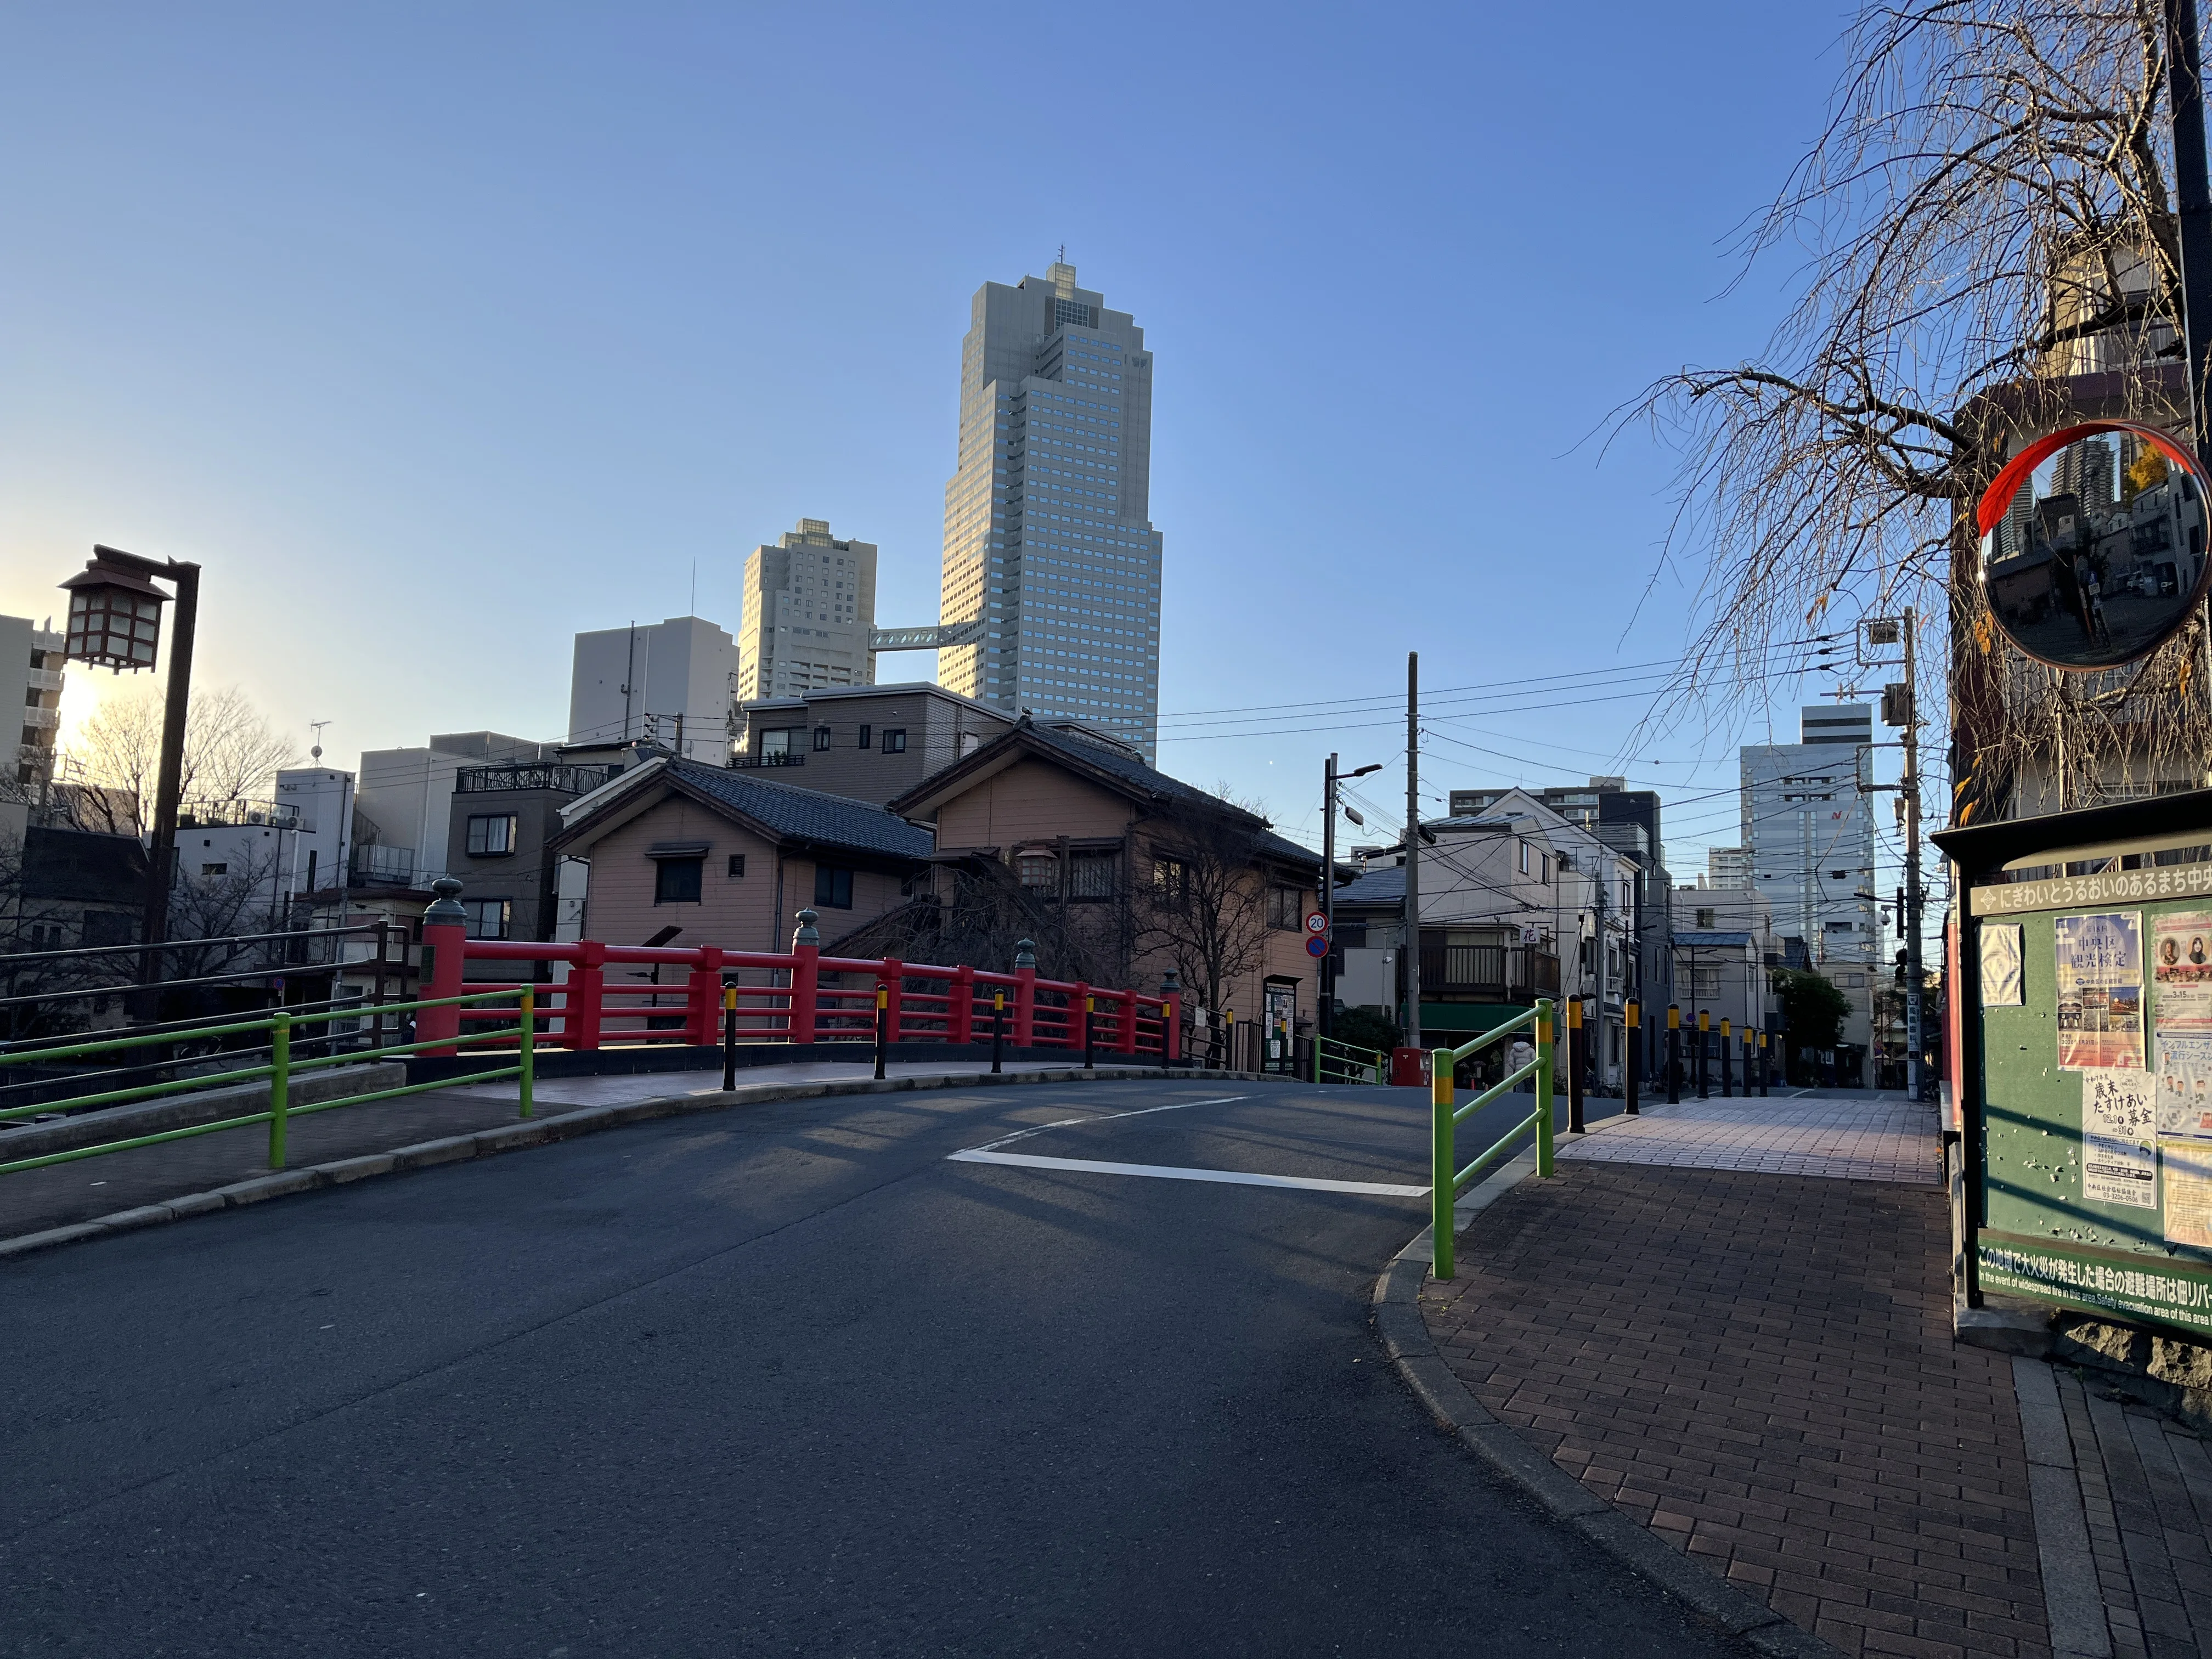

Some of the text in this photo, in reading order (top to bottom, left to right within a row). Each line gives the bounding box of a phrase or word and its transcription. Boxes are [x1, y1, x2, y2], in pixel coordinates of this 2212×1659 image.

[1310, 918, 1324, 928] 20
[1523, 929, 1536, 943] 花
[2079, 935, 2117, 951] 中央区
[2070, 951, 2126, 969] 観光検定
[2095, 1079, 2119, 1099] 歳末
[2093, 1093, 2147, 1114] たすけあい
[2128, 1107, 2153, 1127] 募金
[2103, 1191, 2138, 1203] 03-3206-0506
[1979, 1270, 1985, 1281] In
[1985, 1272, 1994, 1283] the
[1995, 1275, 2011, 1286] event
[2011, 1277, 2018, 1288] of
[2018, 1279, 2051, 1295] widespread
[2052, 1285, 2062, 1297] fire
[2063, 1286, 2069, 1298] in
[2069, 1289, 2081, 1301] this
[2117, 1300, 2153, 1315] evacuation
[2153, 1306, 2170, 1318] area
[2170, 1308, 2178, 1320] of
[2179, 1309, 2192, 1323] this
[2193, 1313, 2209, 1326] area
